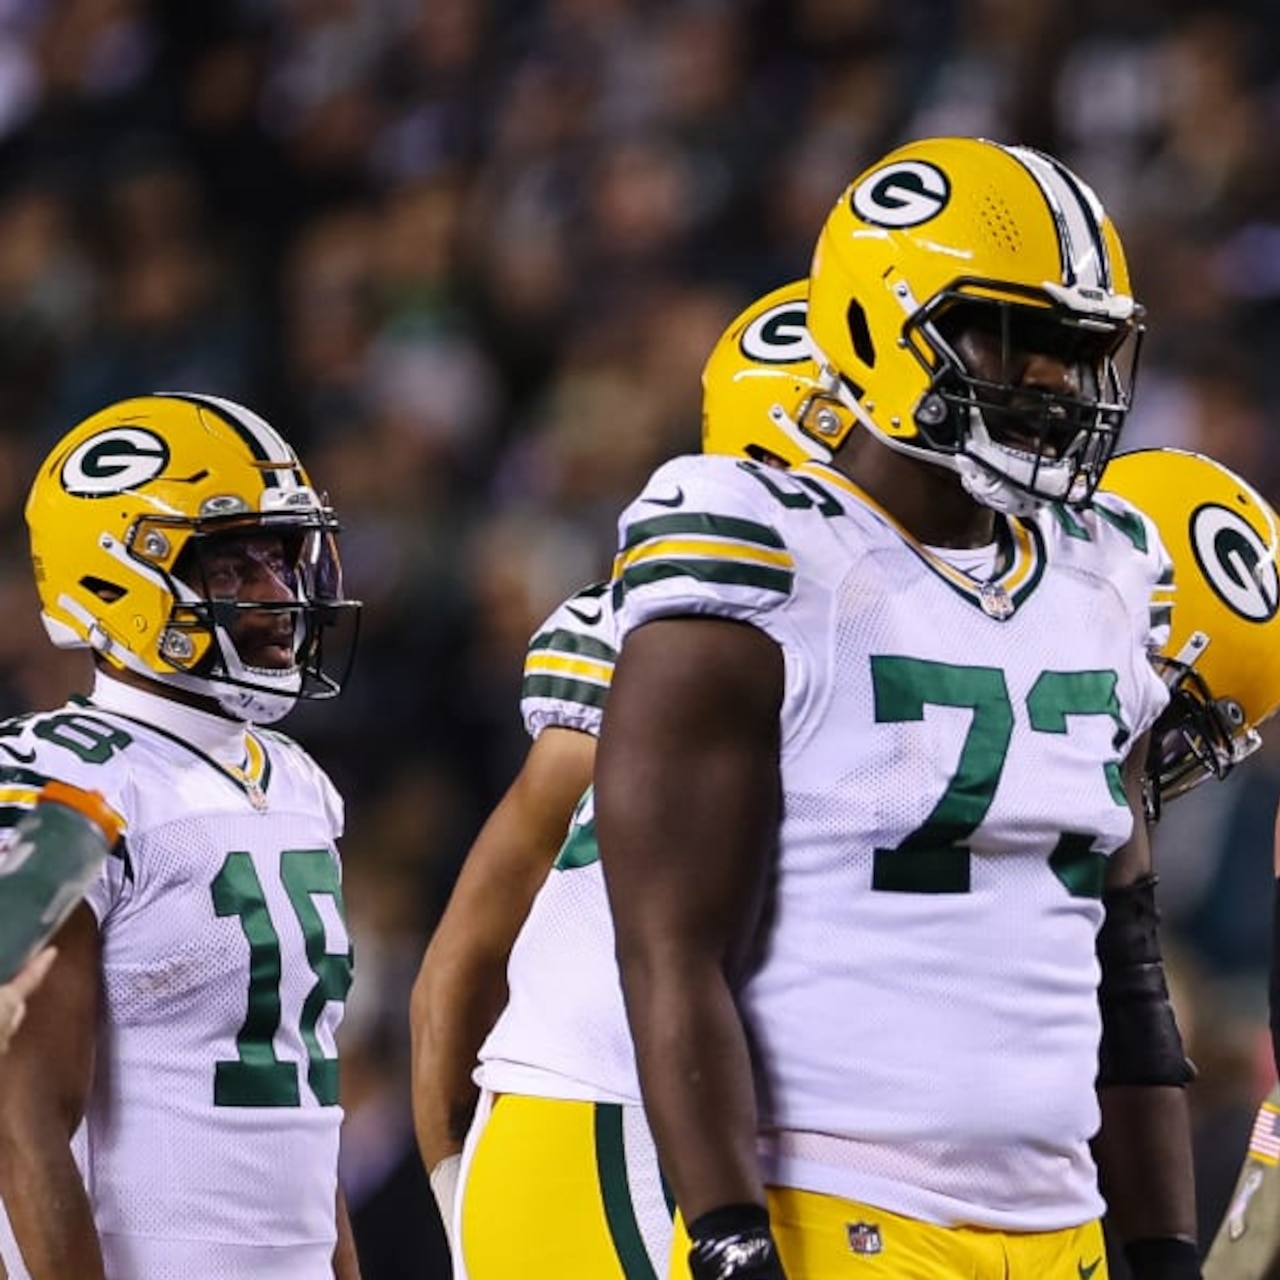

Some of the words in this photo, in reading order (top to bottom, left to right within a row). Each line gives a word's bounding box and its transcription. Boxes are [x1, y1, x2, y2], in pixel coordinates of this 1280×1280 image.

[851, 160, 950, 229] G
[741, 301, 813, 362] G
[61, 427, 169, 496] G
[1189, 503, 1280, 622] G
[870, 654, 1129, 897] 73
